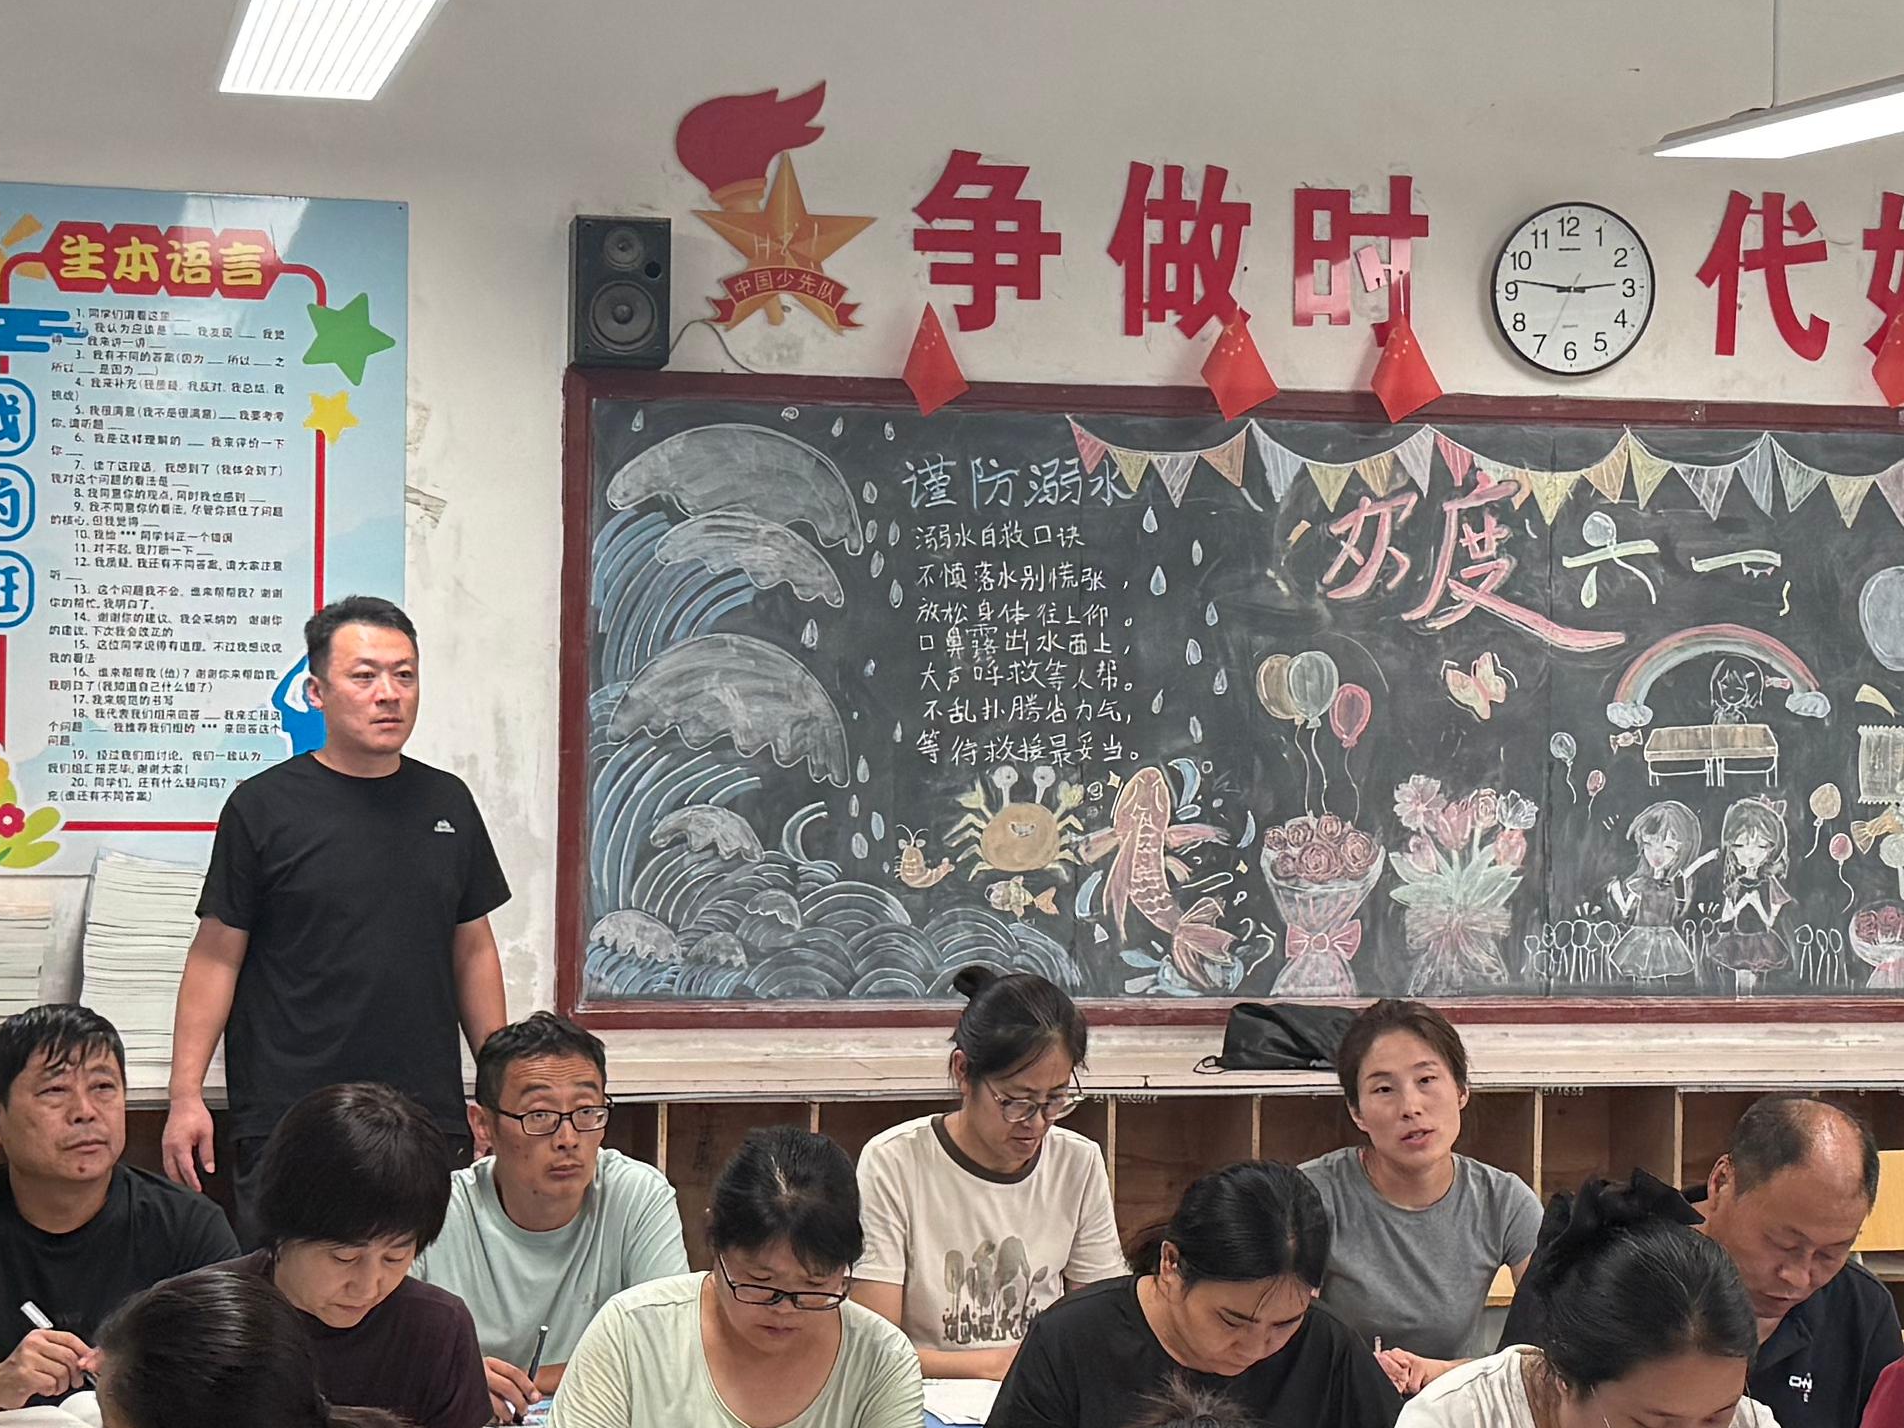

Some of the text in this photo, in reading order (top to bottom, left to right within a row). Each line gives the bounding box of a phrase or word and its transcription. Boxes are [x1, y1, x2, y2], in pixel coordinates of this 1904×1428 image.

[1558, 216, 1581, 237] 12
[1595, 226, 1604, 247] 1
[912, 148, 1430, 340] 争做时
[1531, 228, 1548, 249] 11
[58, 234, 266, 287] 生本语言
[1510, 250, 1532, 271] 10
[1614, 248, 1628, 268] 2
[734, 270, 836, 305] 中国少先队
[1504, 281, 1519, 301] 9
[1622, 278, 1636, 297] 3
[1512, 312, 1526, 332] 8
[1614, 308, 1628, 328] 4
[1532, 333, 1547, 354] 7
[1563, 341, 1577, 361] 6
[1593, 332, 1608, 352] 5
[275, 357, 285, 368] 之
[902, 452, 1137, 510] 谨防溺水
[914, 520, 1086, 552] 溺水自救口诀
